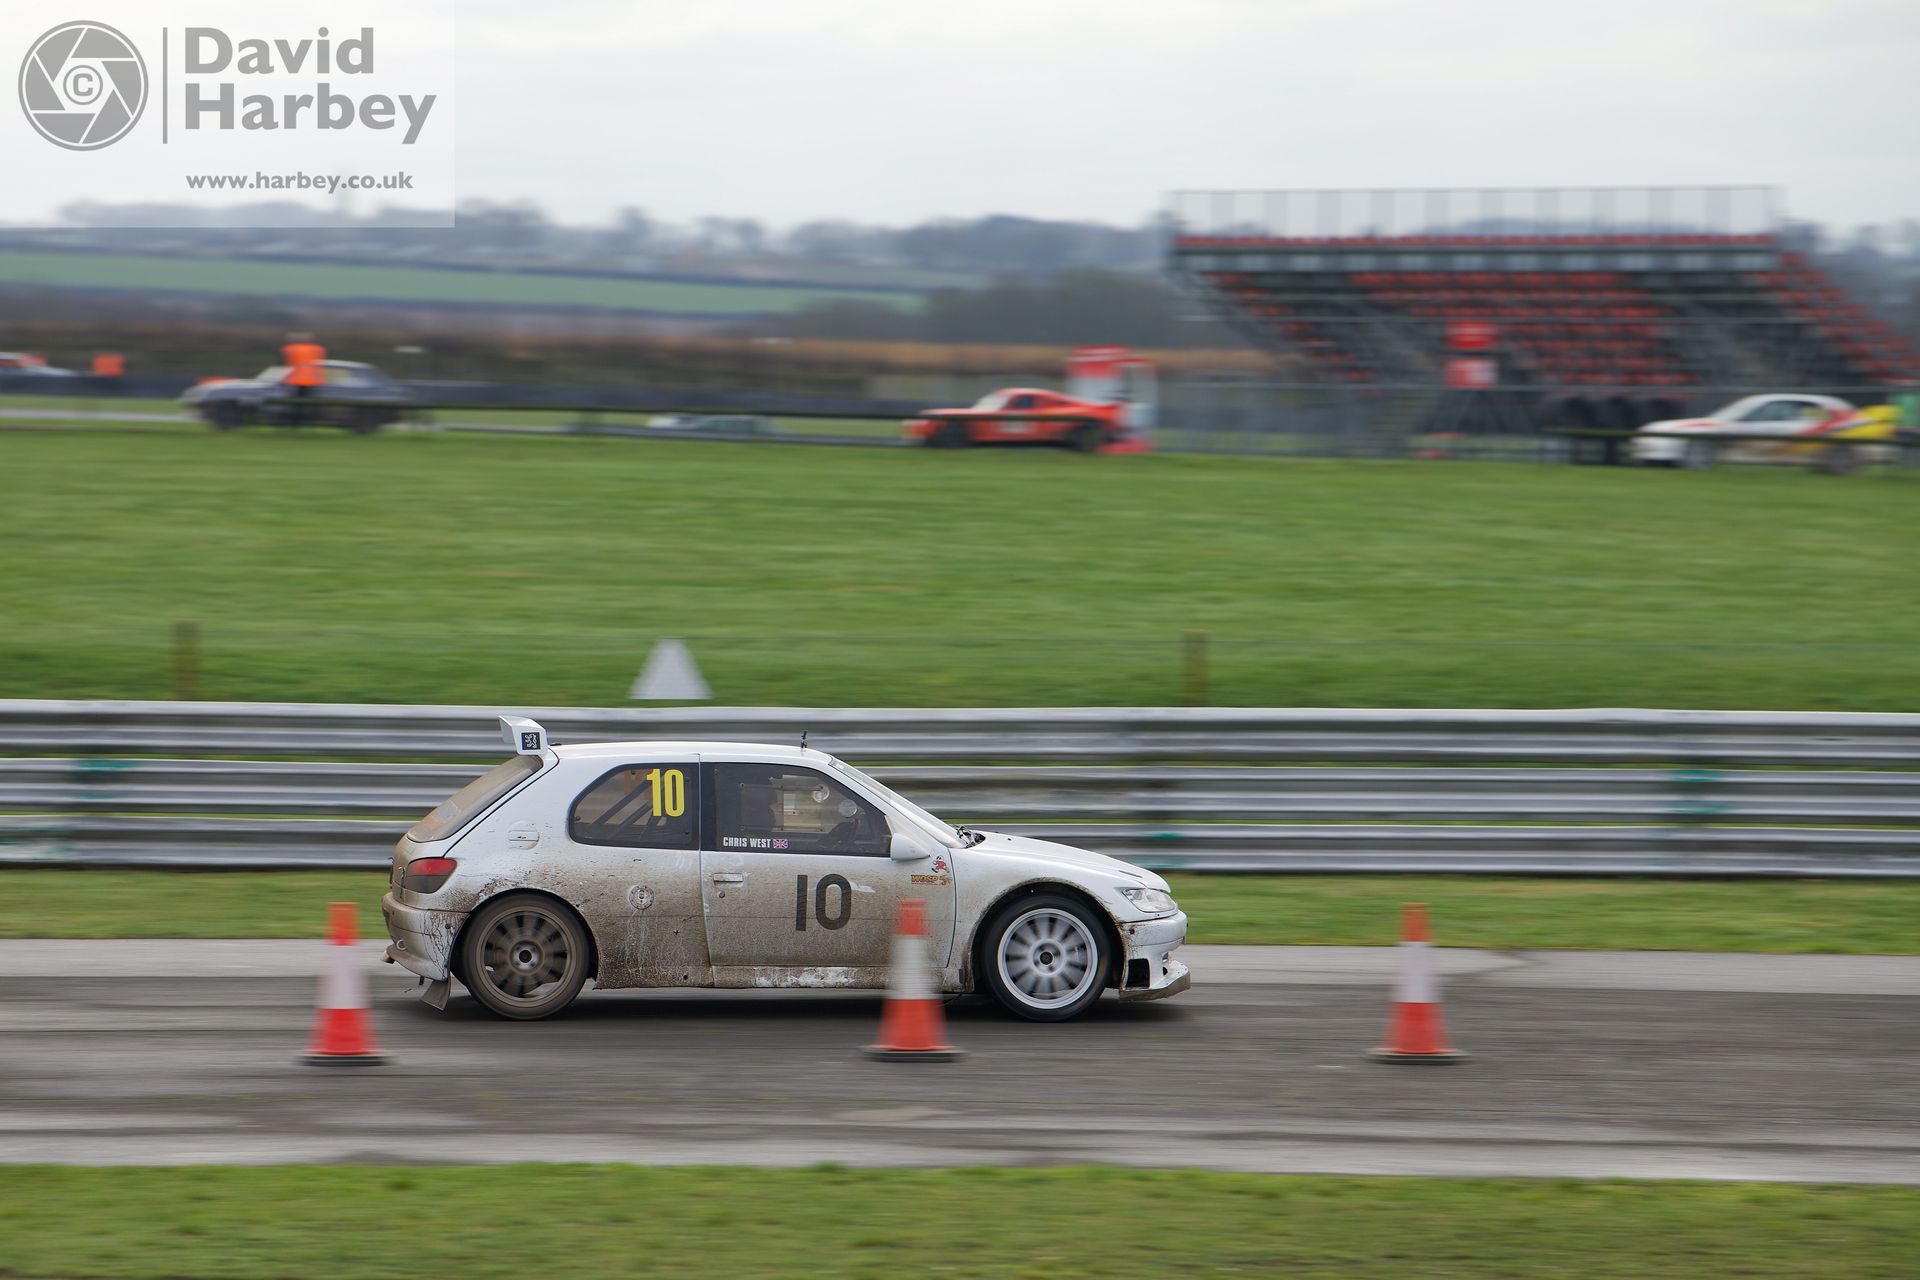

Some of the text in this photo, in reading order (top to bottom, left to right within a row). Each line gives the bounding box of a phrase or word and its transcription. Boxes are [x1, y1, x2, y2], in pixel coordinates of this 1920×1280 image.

[646, 768, 685, 817] 10
[723, 836, 771, 848] CHRIS WEST
[795, 873, 852, 931] 10
